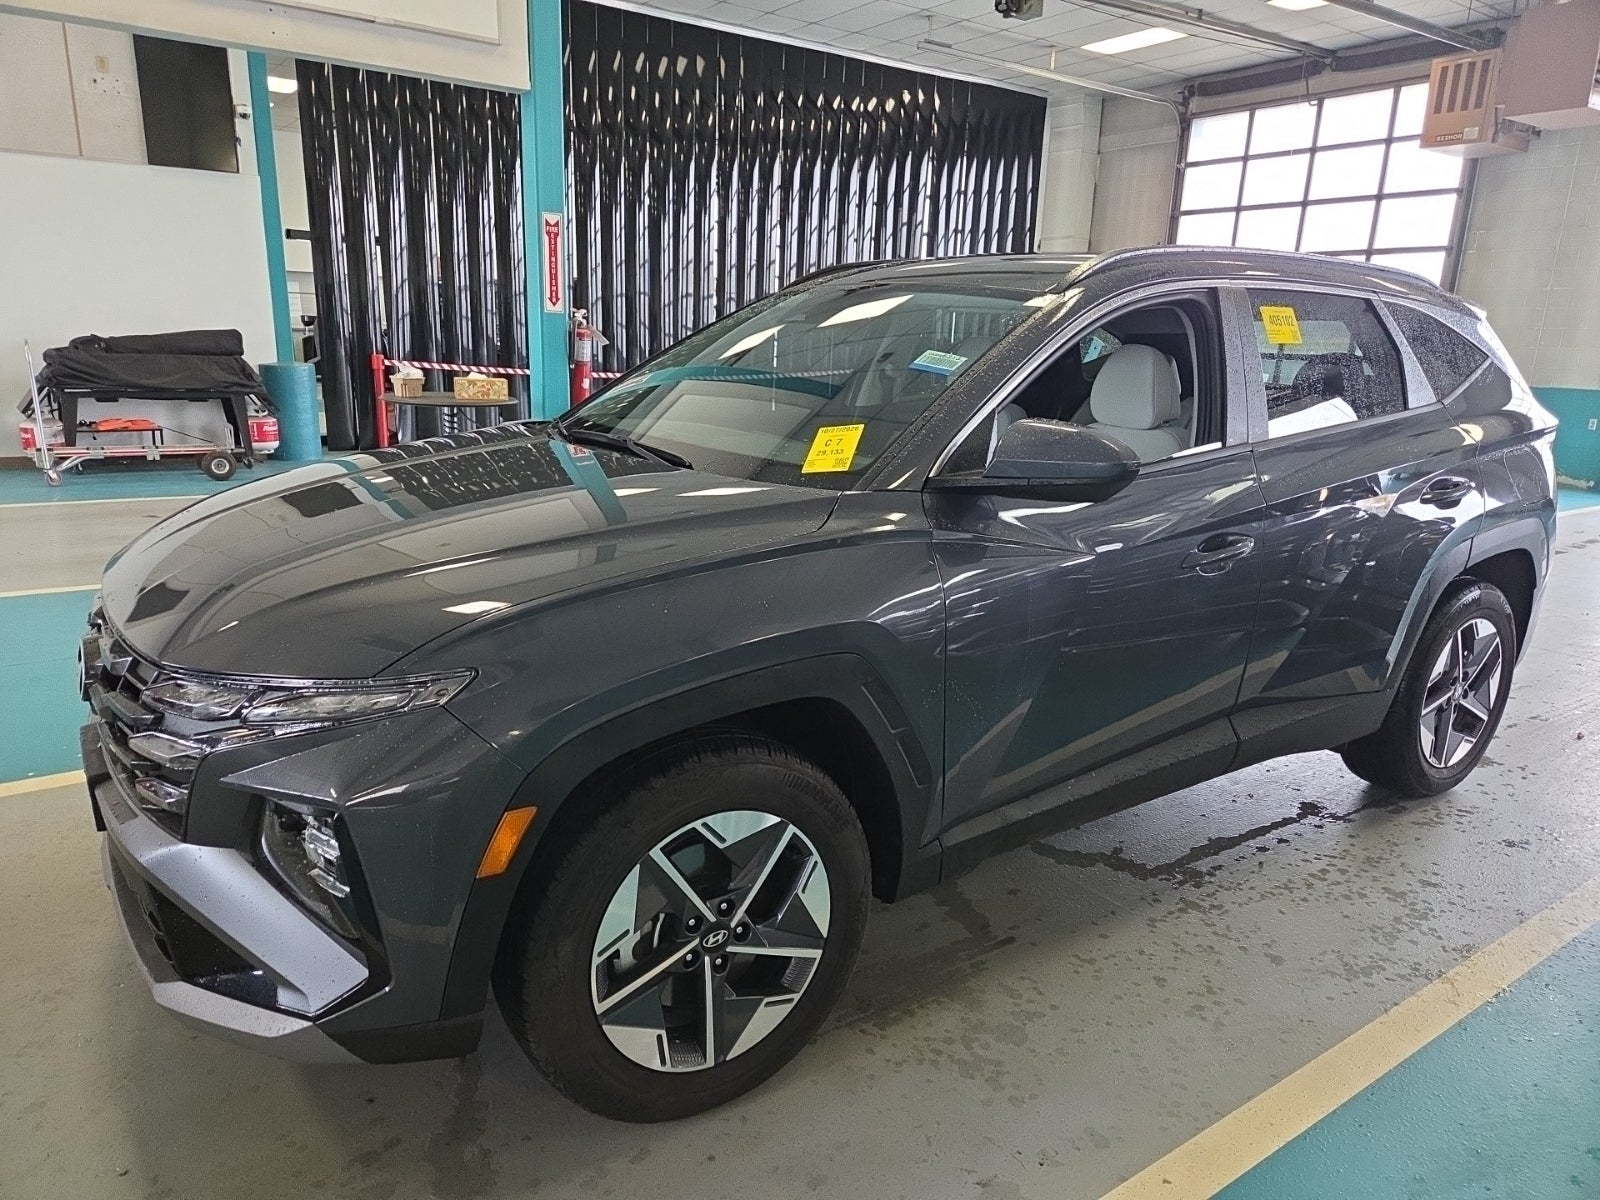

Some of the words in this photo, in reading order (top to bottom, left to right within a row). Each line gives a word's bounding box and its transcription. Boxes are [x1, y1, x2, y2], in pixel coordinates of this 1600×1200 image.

[546, 225, 559, 233] FIRE
[824, 438, 832, 447] C
[836, 438, 843, 446] 7
